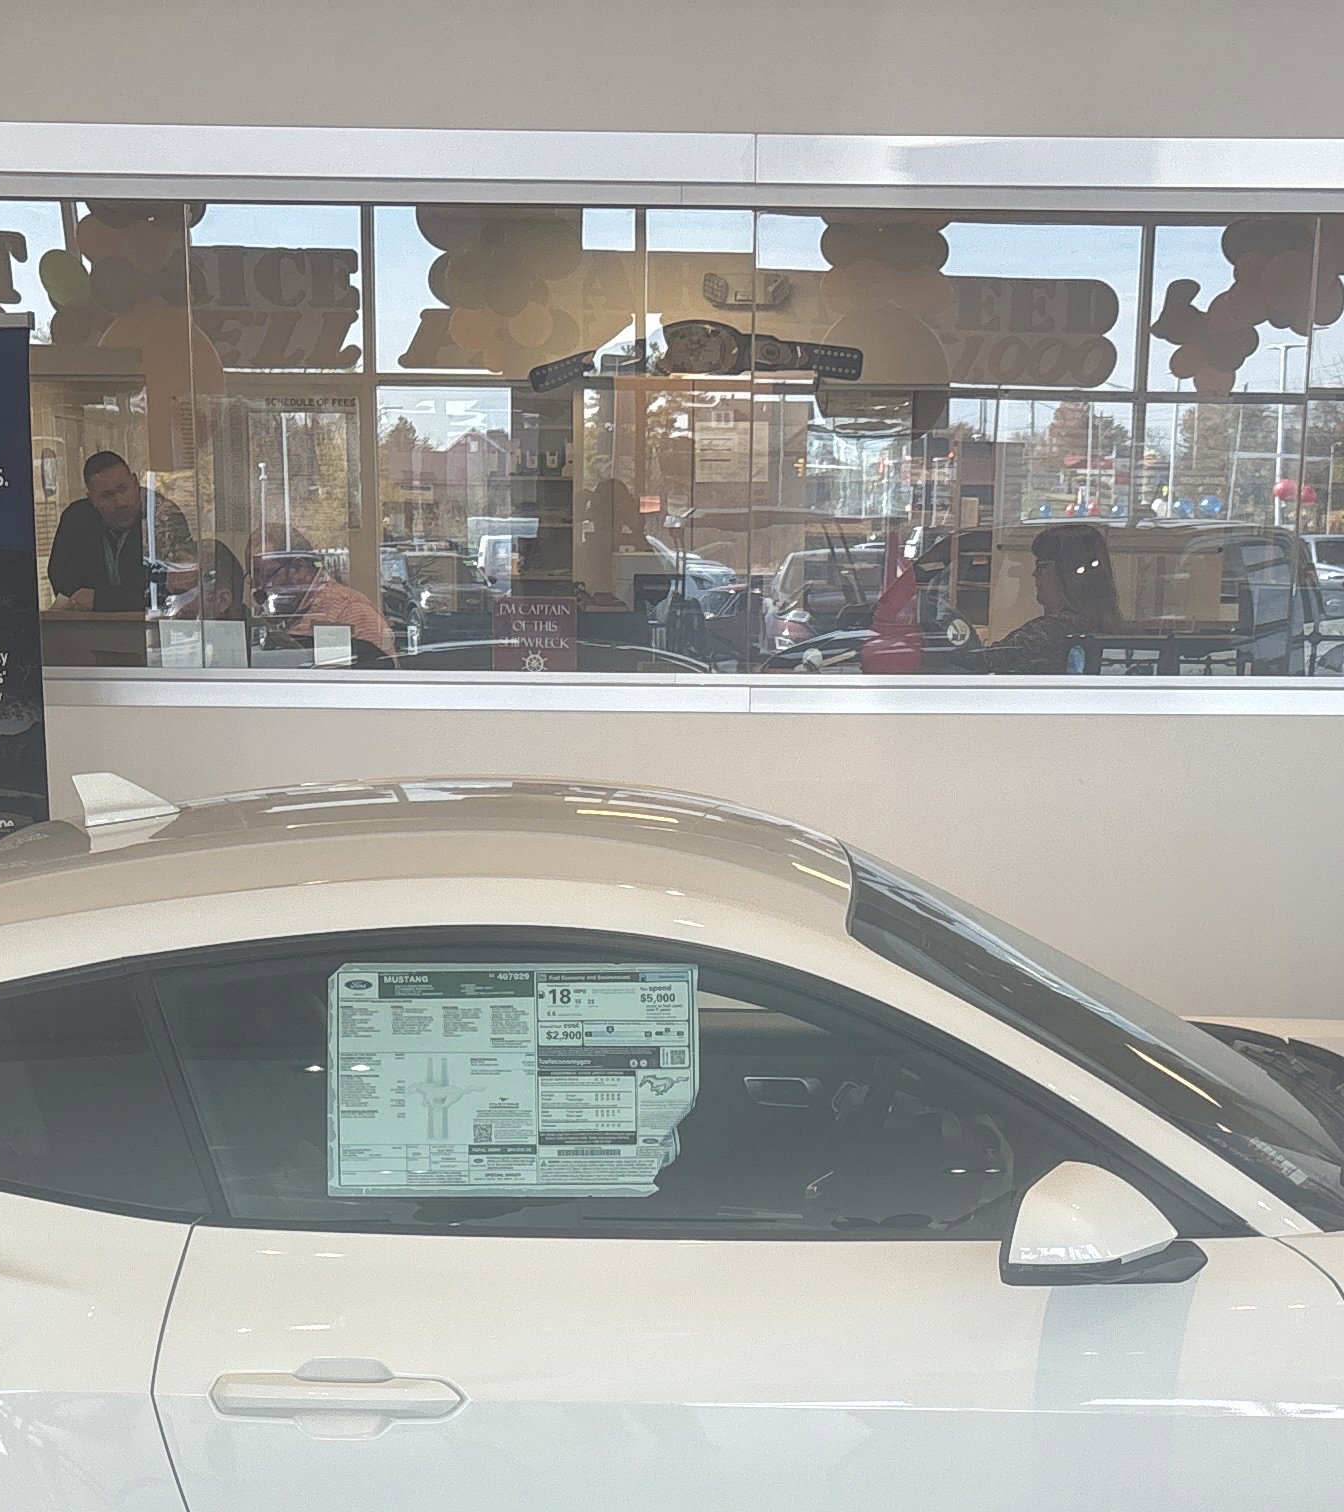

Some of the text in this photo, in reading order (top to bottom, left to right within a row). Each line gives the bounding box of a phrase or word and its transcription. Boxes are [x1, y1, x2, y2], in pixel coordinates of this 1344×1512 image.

[264, 397, 314, 408] SCHEDULE
[519, 603, 571, 616] CAPTAIN
[512, 620, 558, 632] OF THIS
[383, 975, 429, 985] MUSTANG
[548, 988, 571, 1005] 18
[640, 992, 676, 1005] $5,000
[546, 1030, 582, 1041] $2,900
